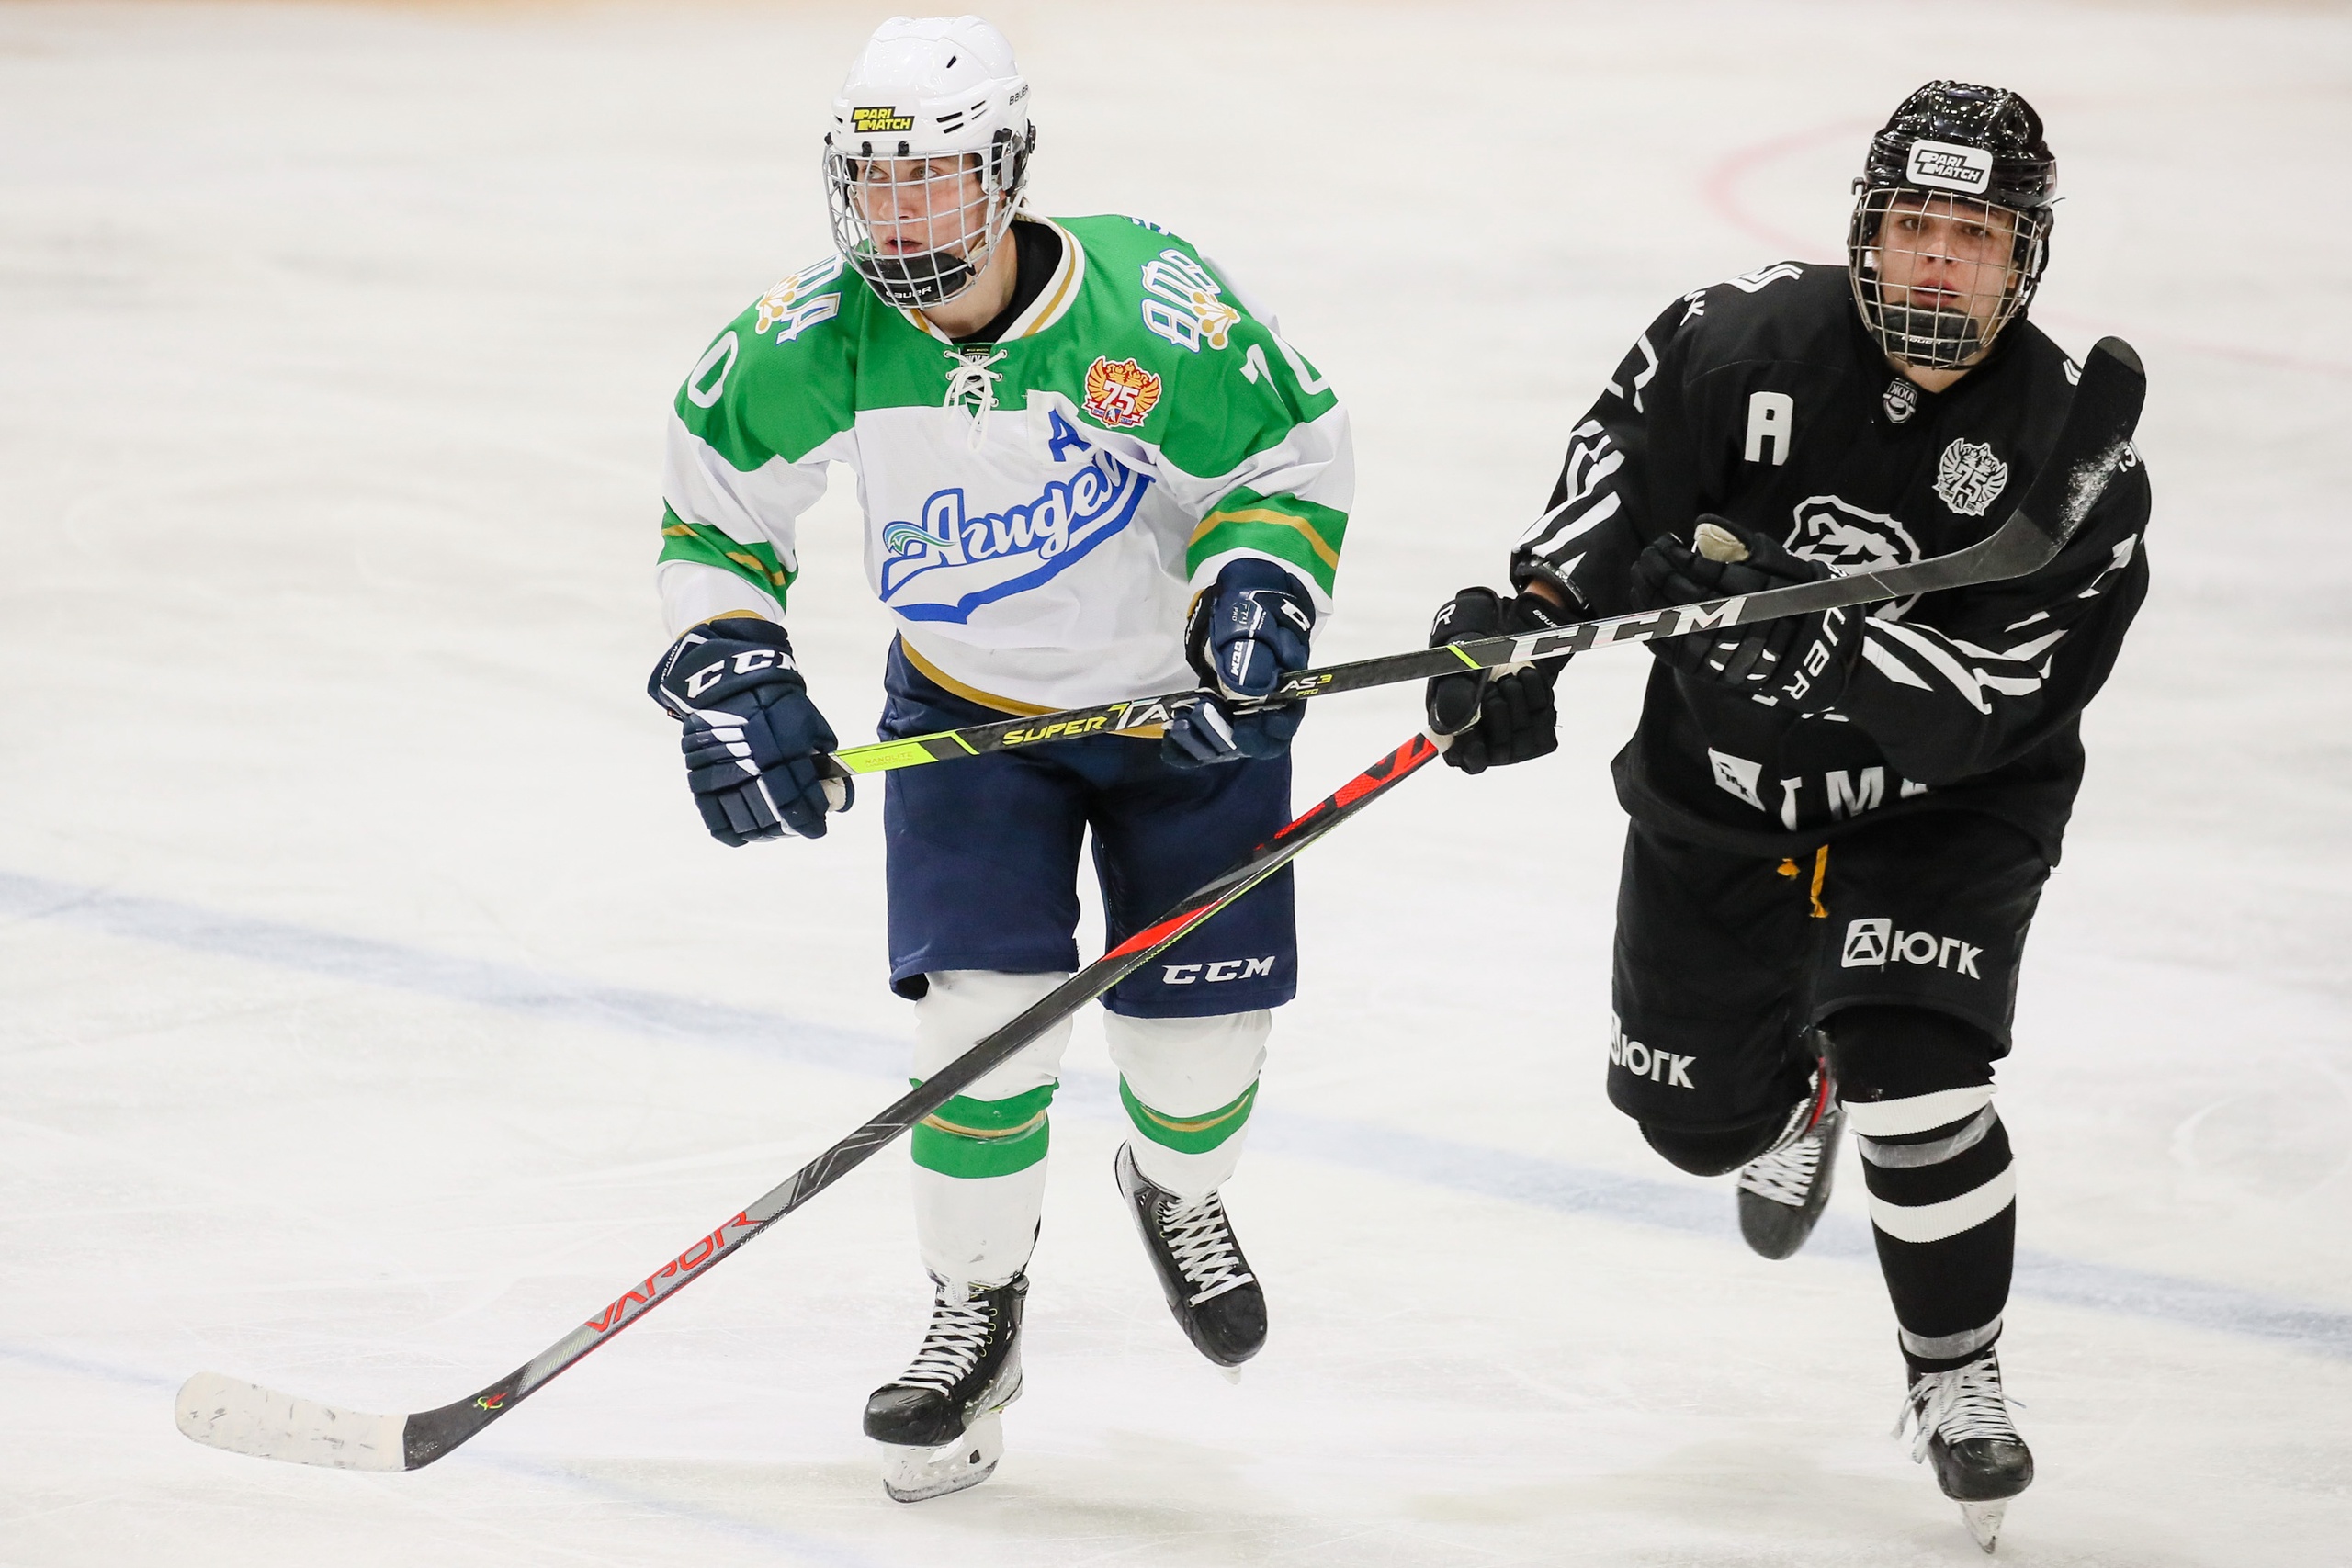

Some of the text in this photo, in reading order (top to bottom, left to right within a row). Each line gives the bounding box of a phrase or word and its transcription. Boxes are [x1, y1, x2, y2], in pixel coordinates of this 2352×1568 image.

[853, 108, 893, 120] PARI
[857, 118, 911, 130] MATCH
[1917, 151, 1963, 167] PARI
[1921, 162, 1981, 181] MATCH
[1099, 378, 1140, 416] 75
[1049, 409, 1092, 462] A
[1745, 391, 1794, 466] A
[1950, 460, 1989, 502] 75
[1509, 597, 1747, 663] CCM
[1532, 609, 1559, 628] BAUE
[1231, 640, 1244, 677] CCM
[1280, 673, 1333, 694] AS3
[1295, 688, 1319, 697] PRO
[1002, 716, 1108, 746] SUPER
[1161, 955, 1276, 985] CCM
[1891, 930, 1984, 980] ЮГК
[1621, 1032, 1697, 1089] ЮГК
[584, 1211, 768, 1333] VAPOR
